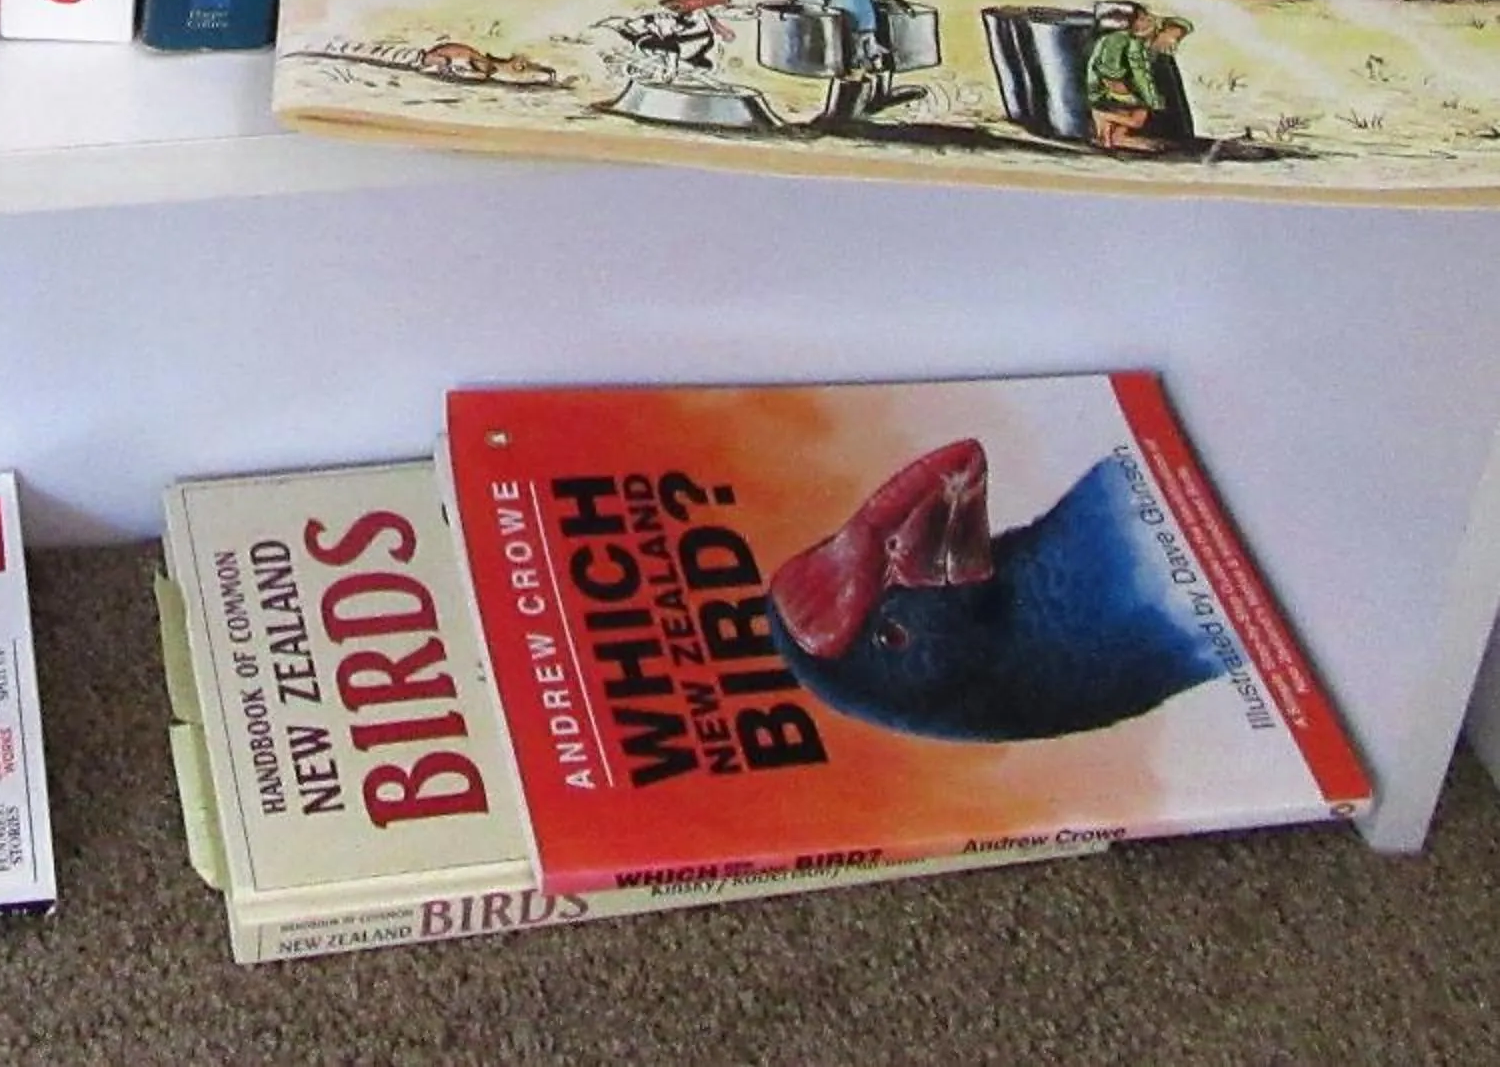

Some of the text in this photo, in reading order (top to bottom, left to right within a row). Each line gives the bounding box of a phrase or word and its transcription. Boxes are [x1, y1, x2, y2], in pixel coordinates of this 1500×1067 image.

[1156, 530, 1198, 585] Dave
[1189, 590, 1213, 616] by
[304, 510, 490, 830] BIRDS
[492, 480, 596, 790] ANDREW CROWE
[552, 475, 699, 788] WHICH
[623, 473, 743, 775] NEW ZEALAND
[657, 470, 828, 771] BIRD?
[214, 550, 287, 815] HANDBOOK OF COMMON
[250, 539, 345, 816] NEW ZEALAND
[1199, 621, 1276, 731] Illustrated
[8, 805, 23, 865] STORIES
[614, 864, 719, 889] WHICH
[963, 827, 1127, 854] Andrew Crowe
[278, 925, 413, 954] NEW ZEALAND
[419, 887, 591, 937] BIRDS
